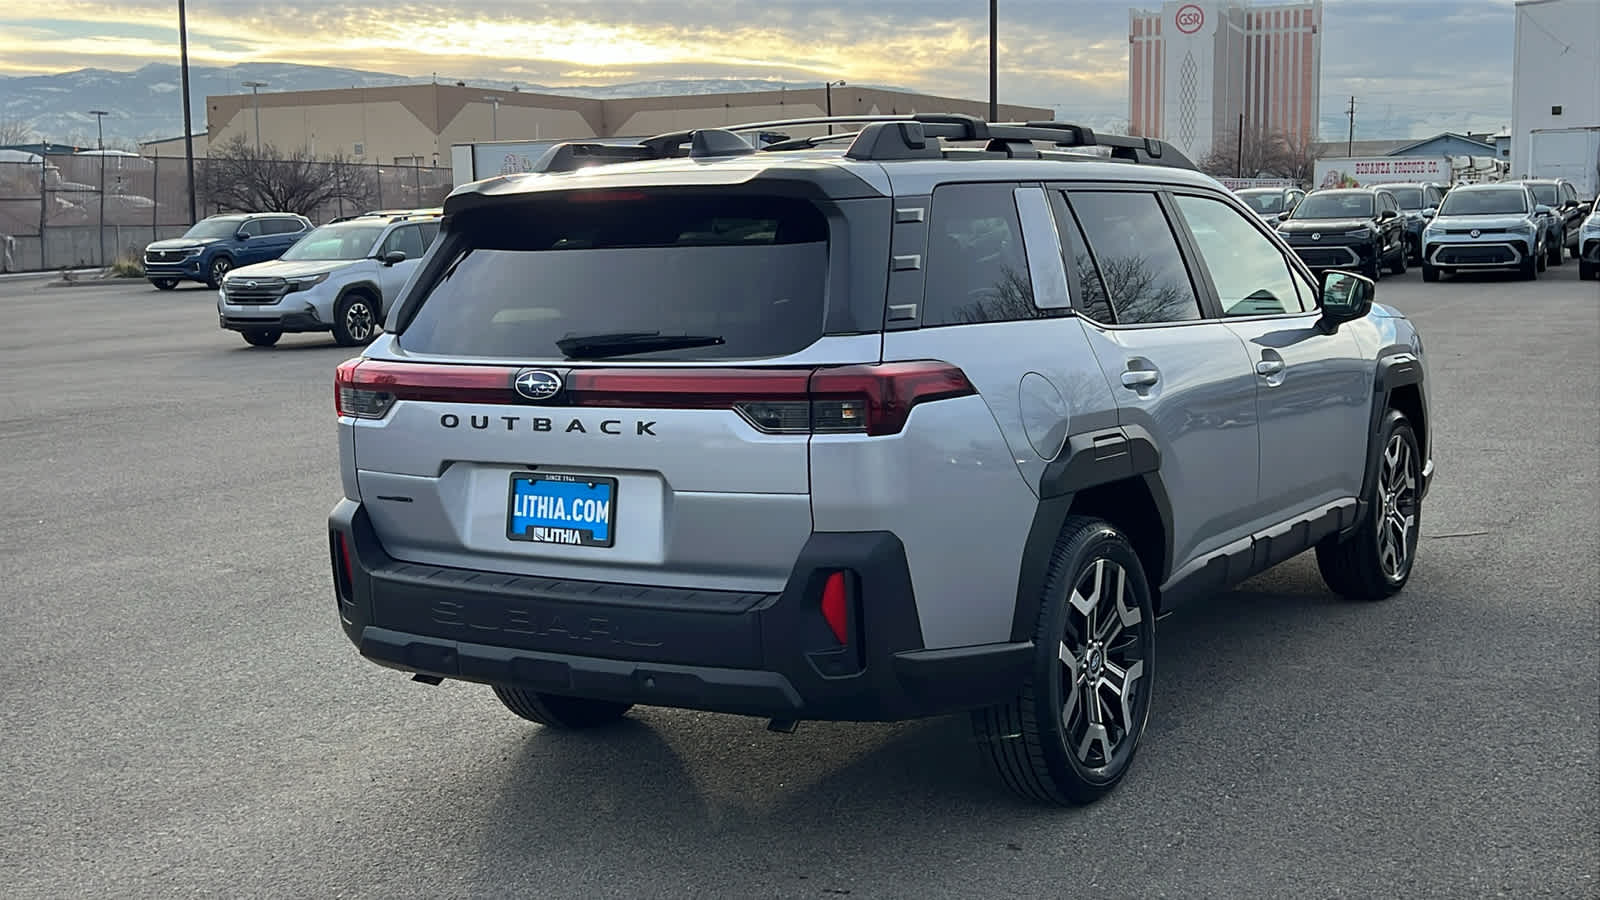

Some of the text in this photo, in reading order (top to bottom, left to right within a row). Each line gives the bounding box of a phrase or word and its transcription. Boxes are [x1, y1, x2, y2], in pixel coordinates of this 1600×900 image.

[1179, 13, 1200, 25] GSR
[441, 414, 657, 436] OUTBACK
[514, 494, 609, 524] LITHIA.COM
[544, 527, 581, 544] LITHIA
